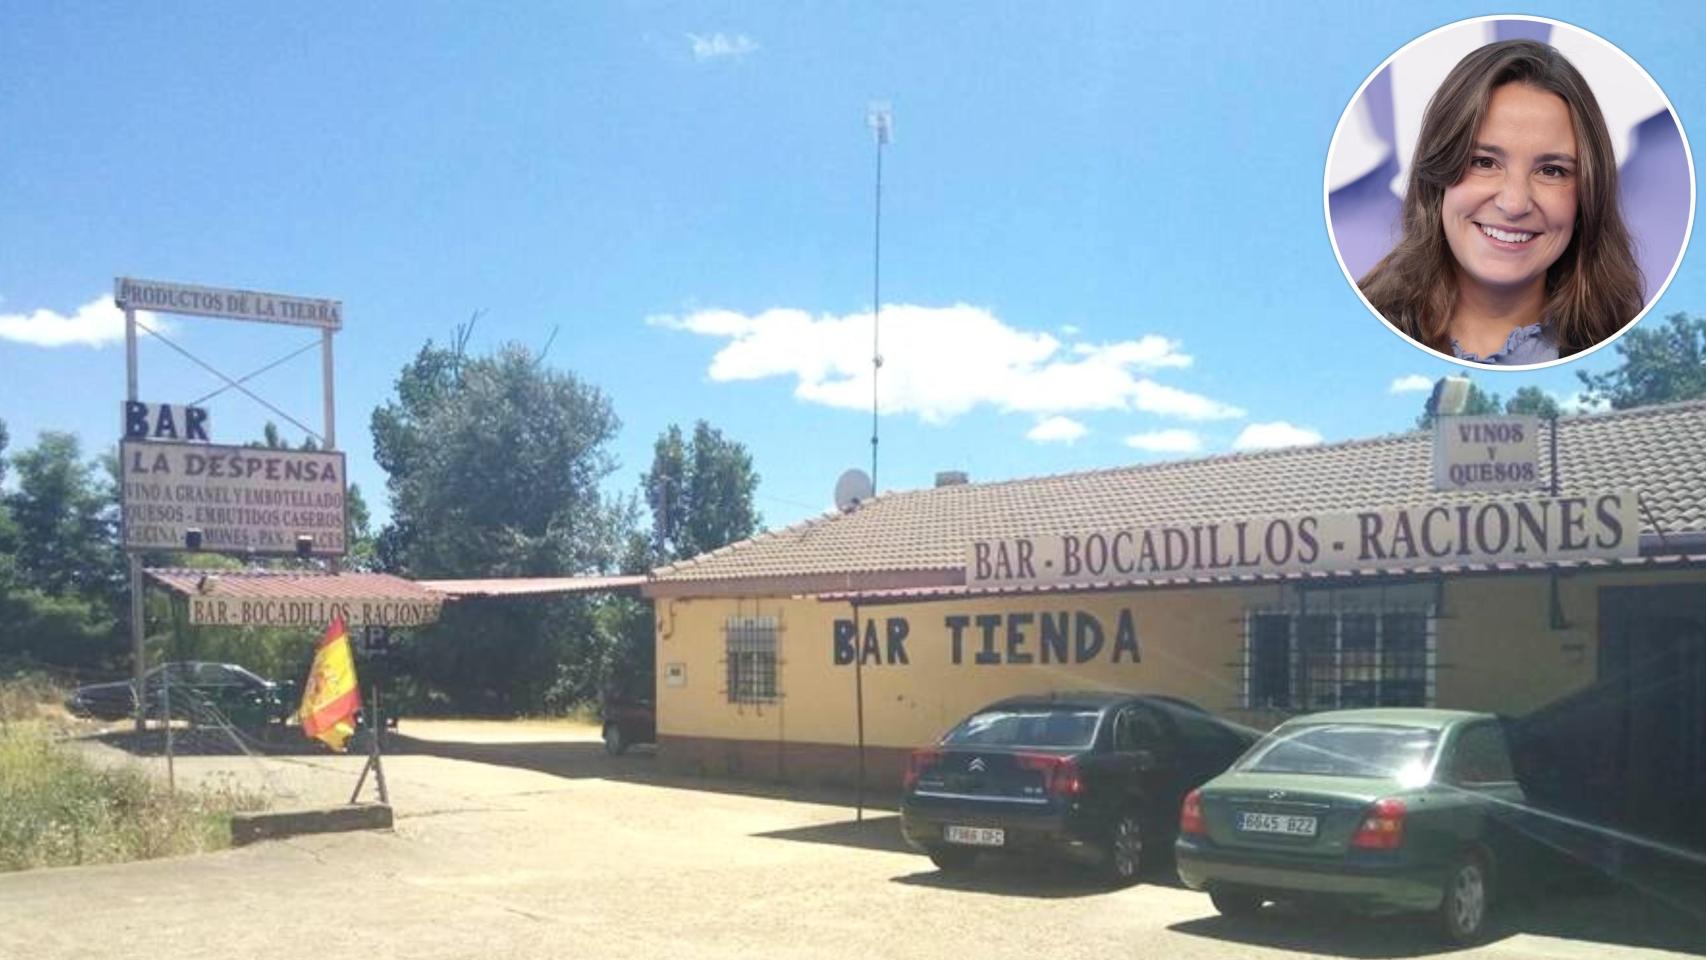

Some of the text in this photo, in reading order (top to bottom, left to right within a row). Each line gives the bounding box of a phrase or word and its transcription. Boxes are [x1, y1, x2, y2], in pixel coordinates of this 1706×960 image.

[121, 281, 340, 322] PRODUCTOS DE LA TIERRA
[125, 400, 209, 441] BAR
[1458, 423, 1525, 444] VINOS
[1487, 446, 1497, 461] Y
[131, 451, 337, 483] LA DESPENSA
[1449, 461, 1536, 486] QUESOS
[126, 482, 342, 509] VINO A GRANEL Y EMBOTELLADO
[126, 503, 184, 523] QUESOS
[195, 506, 280, 526] EMBUTIDOS
[282, 510, 343, 529] CASEROS
[127, 525, 177, 543] CECINA
[202, 528, 249, 545] MONES
[259, 529, 284, 546] PAN
[974, 538, 1036, 581] BAR
[1062, 515, 1320, 578] BOCADILLOS
[1357, 494, 1623, 562] RACIONES
[194, 600, 228, 624] BAR
[241, 600, 350, 625] BOCADILLOS
[362, 602, 440, 625] RACIONES
[833, 607, 1142, 666] BAR TIENDA
